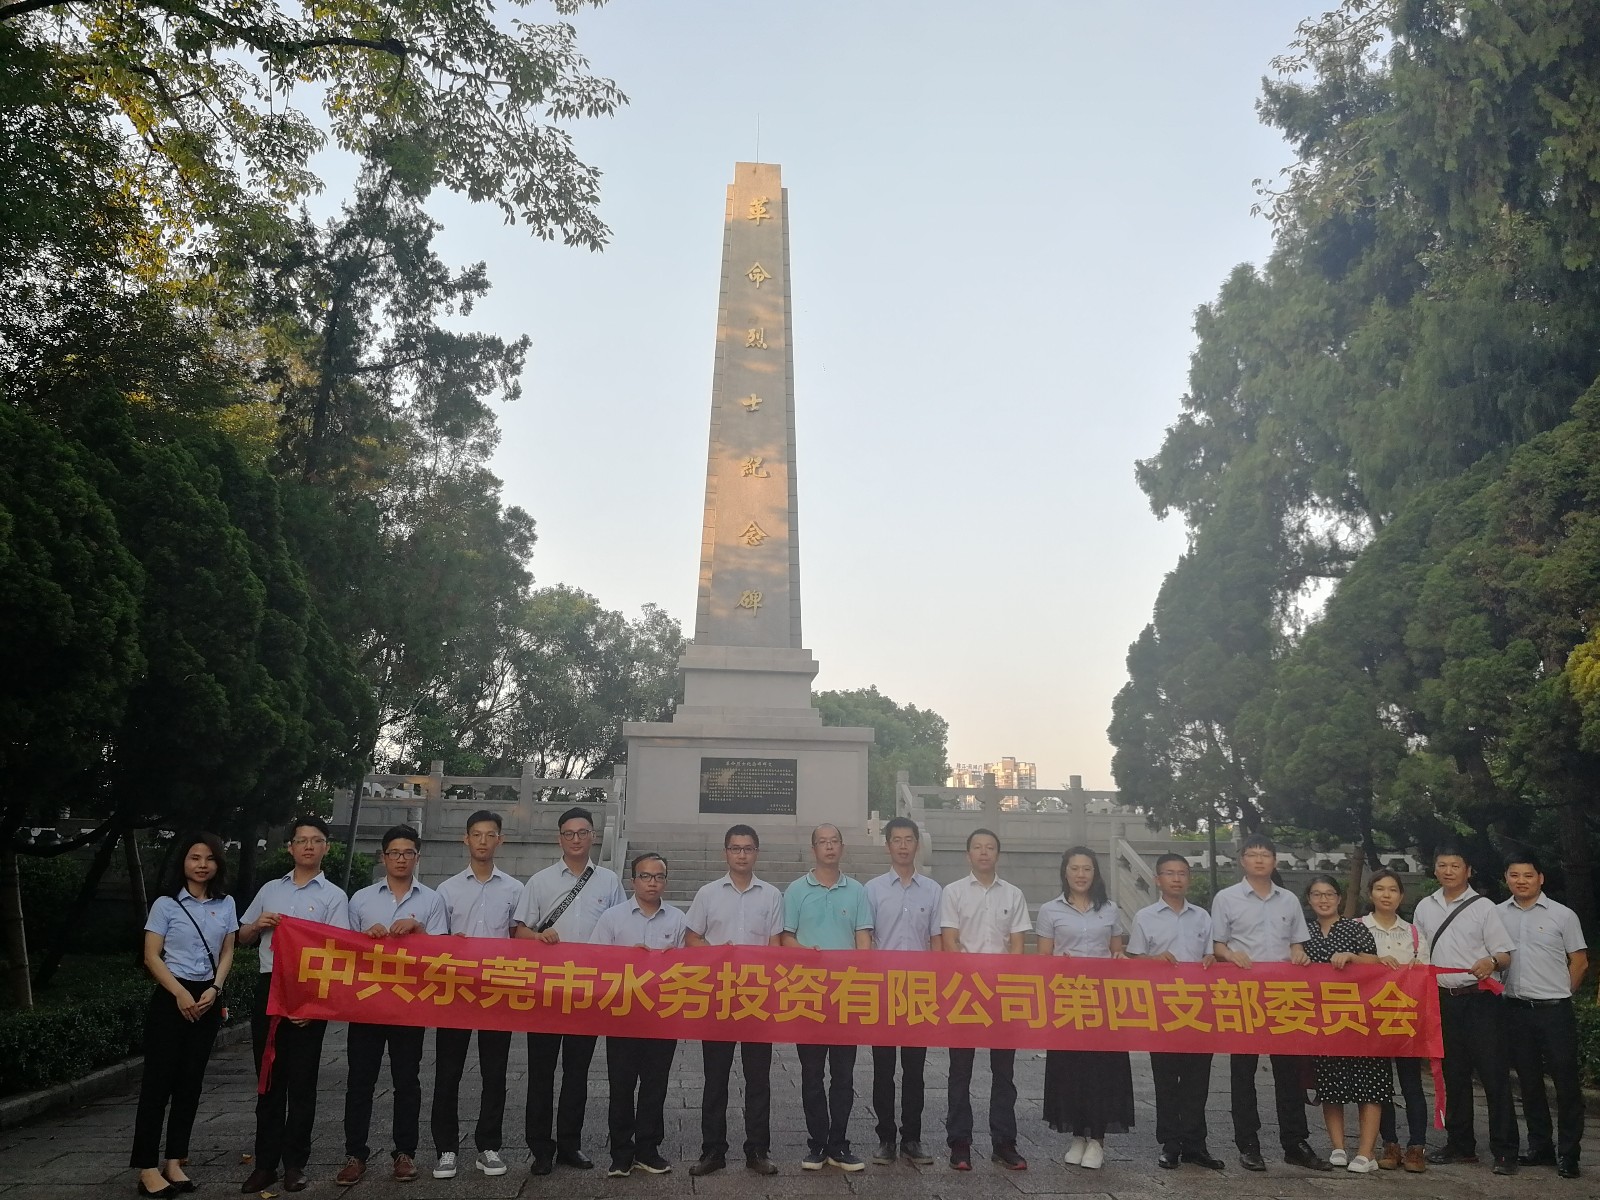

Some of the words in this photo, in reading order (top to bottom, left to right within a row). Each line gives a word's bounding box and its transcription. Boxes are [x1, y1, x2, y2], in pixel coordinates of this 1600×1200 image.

[298, 938, 1418, 1036] 中共东莞市水务投资有限公司第四支部委员会
